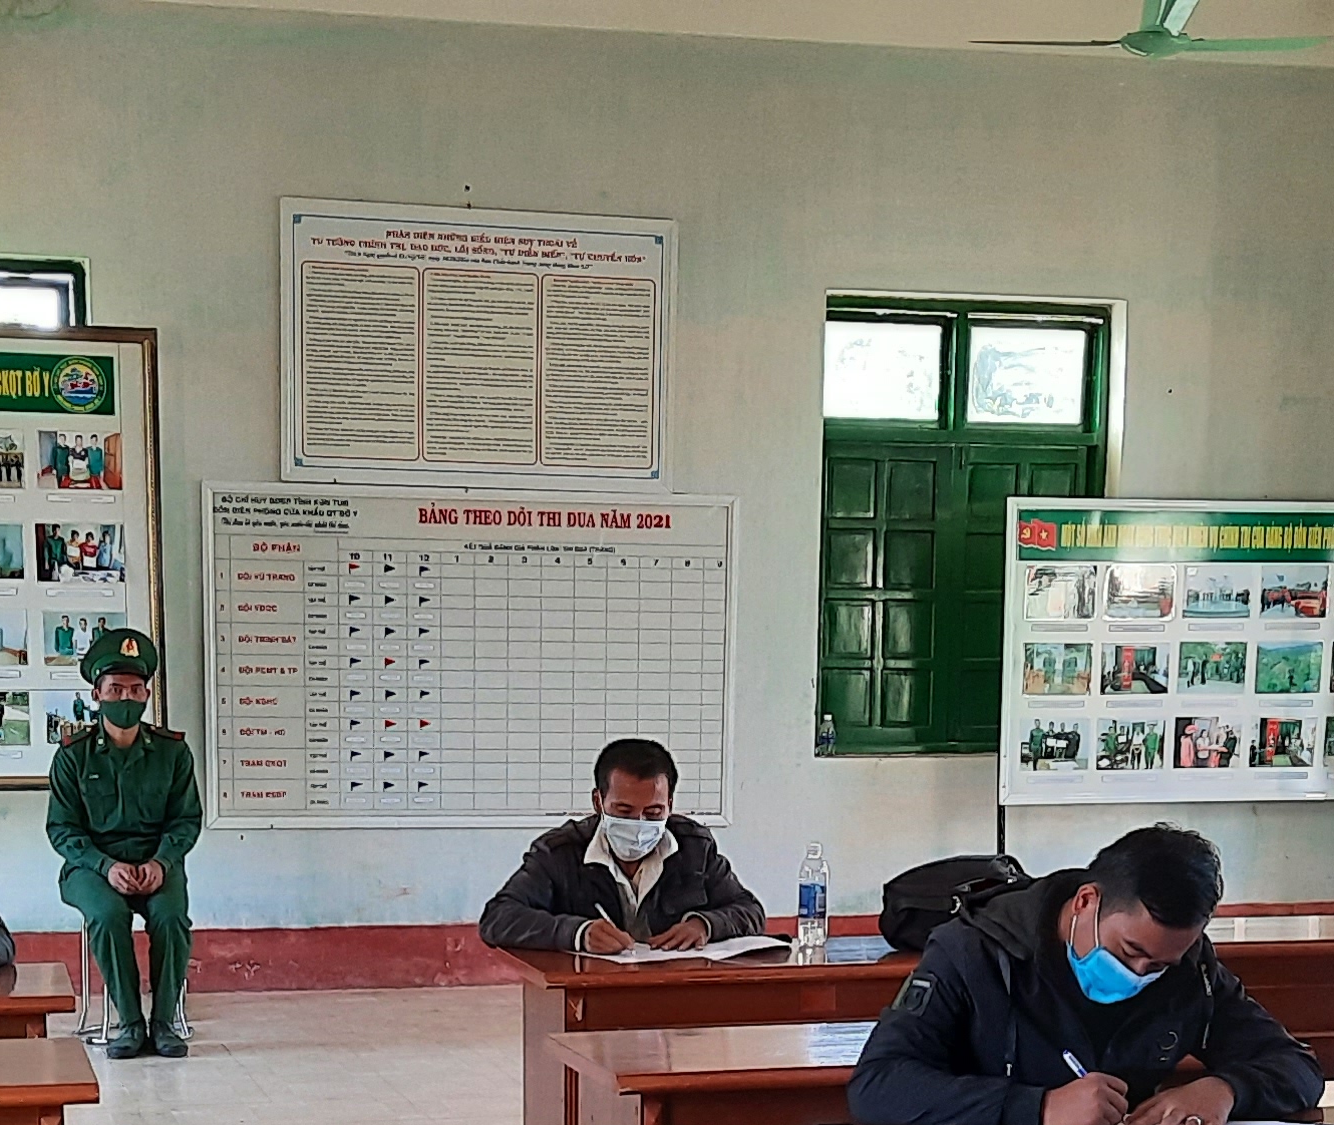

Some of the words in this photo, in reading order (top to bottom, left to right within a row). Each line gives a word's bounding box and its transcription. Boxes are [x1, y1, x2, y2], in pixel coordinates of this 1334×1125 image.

[42, 370, 50, 397] Y
[418, 502, 458, 525] BẢNG
[463, 509, 503, 526] THEO
[507, 506, 532, 527] DÕI
[537, 510, 561, 527] THI
[601, 509, 631, 529] NĂM
[636, 514, 671, 529] 2021
[383, 553, 393, 561] 11
[454, 555, 459, 563] 1
